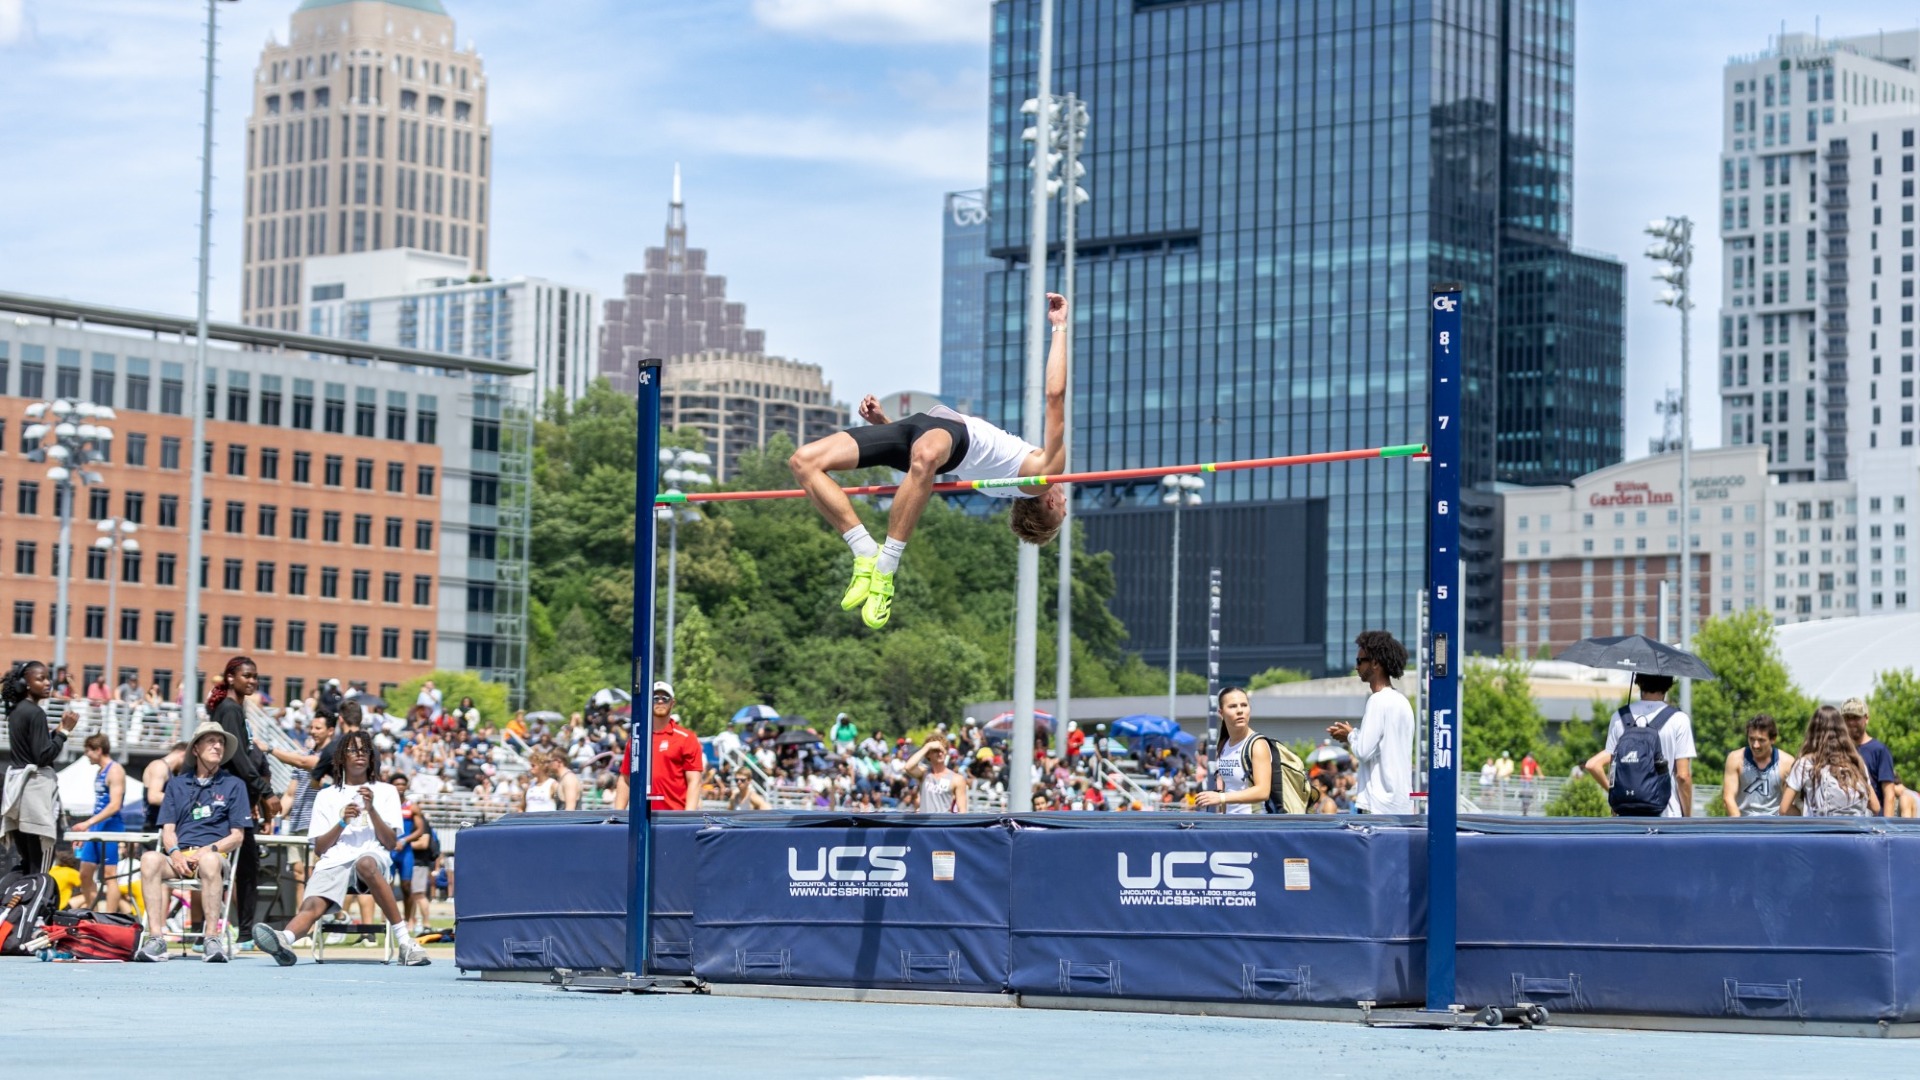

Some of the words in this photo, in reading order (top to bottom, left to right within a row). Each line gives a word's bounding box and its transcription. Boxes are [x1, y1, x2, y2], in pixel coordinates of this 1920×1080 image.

[1439, 331, 1450, 345] 8
[1438, 416, 1449, 429] 7
[1590, 490, 1643, 507] Garden
[1647, 489, 1674, 505] Inn
[1437, 500, 1448, 514] 6
[1437, 585, 1448, 599] 5
[1439, 709, 1452, 769] UCS
[1218, 759, 1240, 767] EORGIA
[788, 846, 907, 881] UCS
[1118, 851, 1254, 890] UCS
[789, 887, 909, 897] WWW.UCSSPIRIT.COM
[1120, 896, 1256, 907] WWW.UCSSPIRIT.COM
